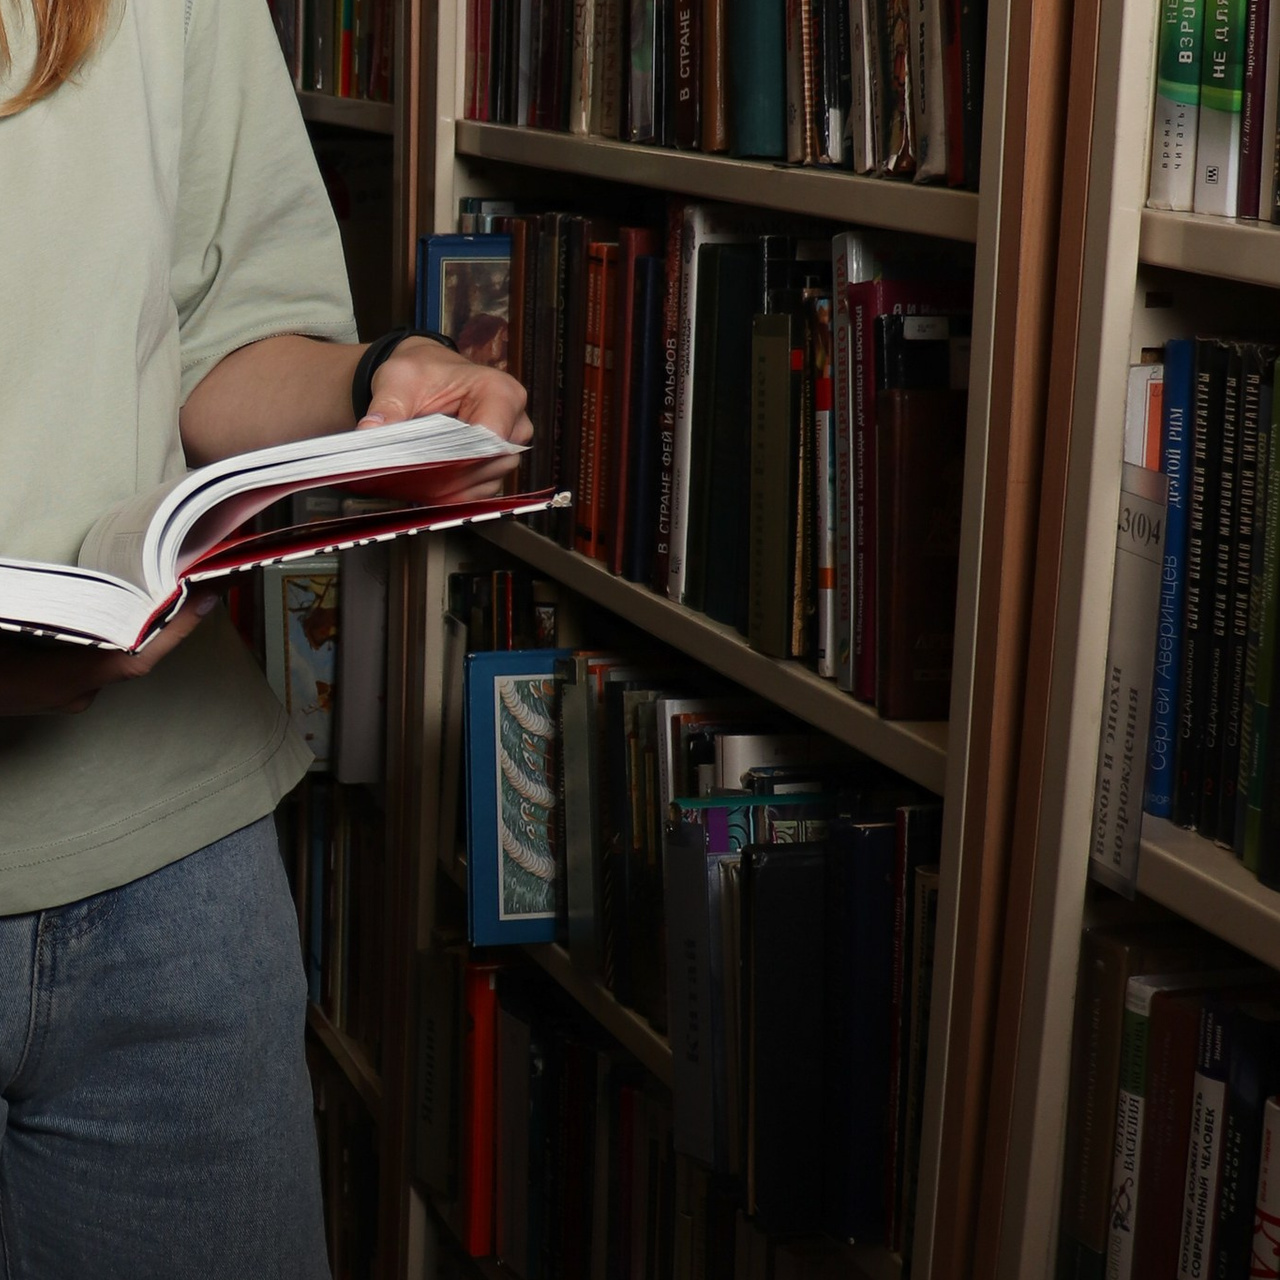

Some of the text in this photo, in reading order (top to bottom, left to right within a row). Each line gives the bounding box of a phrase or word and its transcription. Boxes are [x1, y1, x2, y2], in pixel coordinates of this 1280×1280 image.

[679, 8, 691, 78] СТРАНЕ
[1212, 50, 1227, 78] НЕ
[1246, 13, 1260, 79] Зарубежная
[679, 87, 690, 101] В
[1161, 117, 1171, 169] время
[1174, 103, 1187, 169] читать!
[677, 272, 689, 419] ГРЕЧЕСКАЯ МИФОЛОГИЯ
[854, 305, 864, 361] ВОСТОКА
[855, 363, 865, 427] ДРЕВНЕГО
[1193, 372, 1211, 460] ЛИТЕРАТУРЫ
[1219, 376, 1238, 464] ЛИТЕРАТУРЫ
[1240, 373, 1260, 462] ЛИТЕРАТУРЫ
[658, 337, 677, 555] В СТРАНЕ ФЕЙ И ЭЛЬФОВ
[834, 252, 851, 622] БОГИ И ГЕРОИ ДРЕВНЕГО МИРА
[1163, 407, 1184, 509] ДРУГОЙ РИМ
[1190, 466, 1205, 530] МИРОВОЙ
[1216, 470, 1232, 536] МИРОВОЙ
[1237, 468, 1255, 536] МИРОВОЙ
[1187, 537, 1202, 579] ВЕКОВ
[1213, 543, 1228, 585] ВЕКОВ
[1235, 542, 1251, 584] ВЕКОВ
[1156, 554, 1179, 679] Аверинцев
[1186, 585, 1200, 630] СОРОК
[1211, 592, 1227, 637] СОРОК
[1232, 591, 1249, 636] СОРОК
[1093, 665, 1122, 855] веков и эпохи
[1150, 686, 1173, 770] Сергей
[1110, 686, 1140, 867] возрождения
[1123, 1020, 1146, 1172] ВАСИЛИЯ АКСЕНОВА
[1180, 1091, 1204, 1273] КОТОРЫЕ ДОЛЖЕН ЗНАТЬ
[1191, 1106, 1216, 1279] СОВРЕМЕННЫЙ ЧЕЛОВЕК
[1228, 1130, 1243, 1214] КРАСОТЫ
